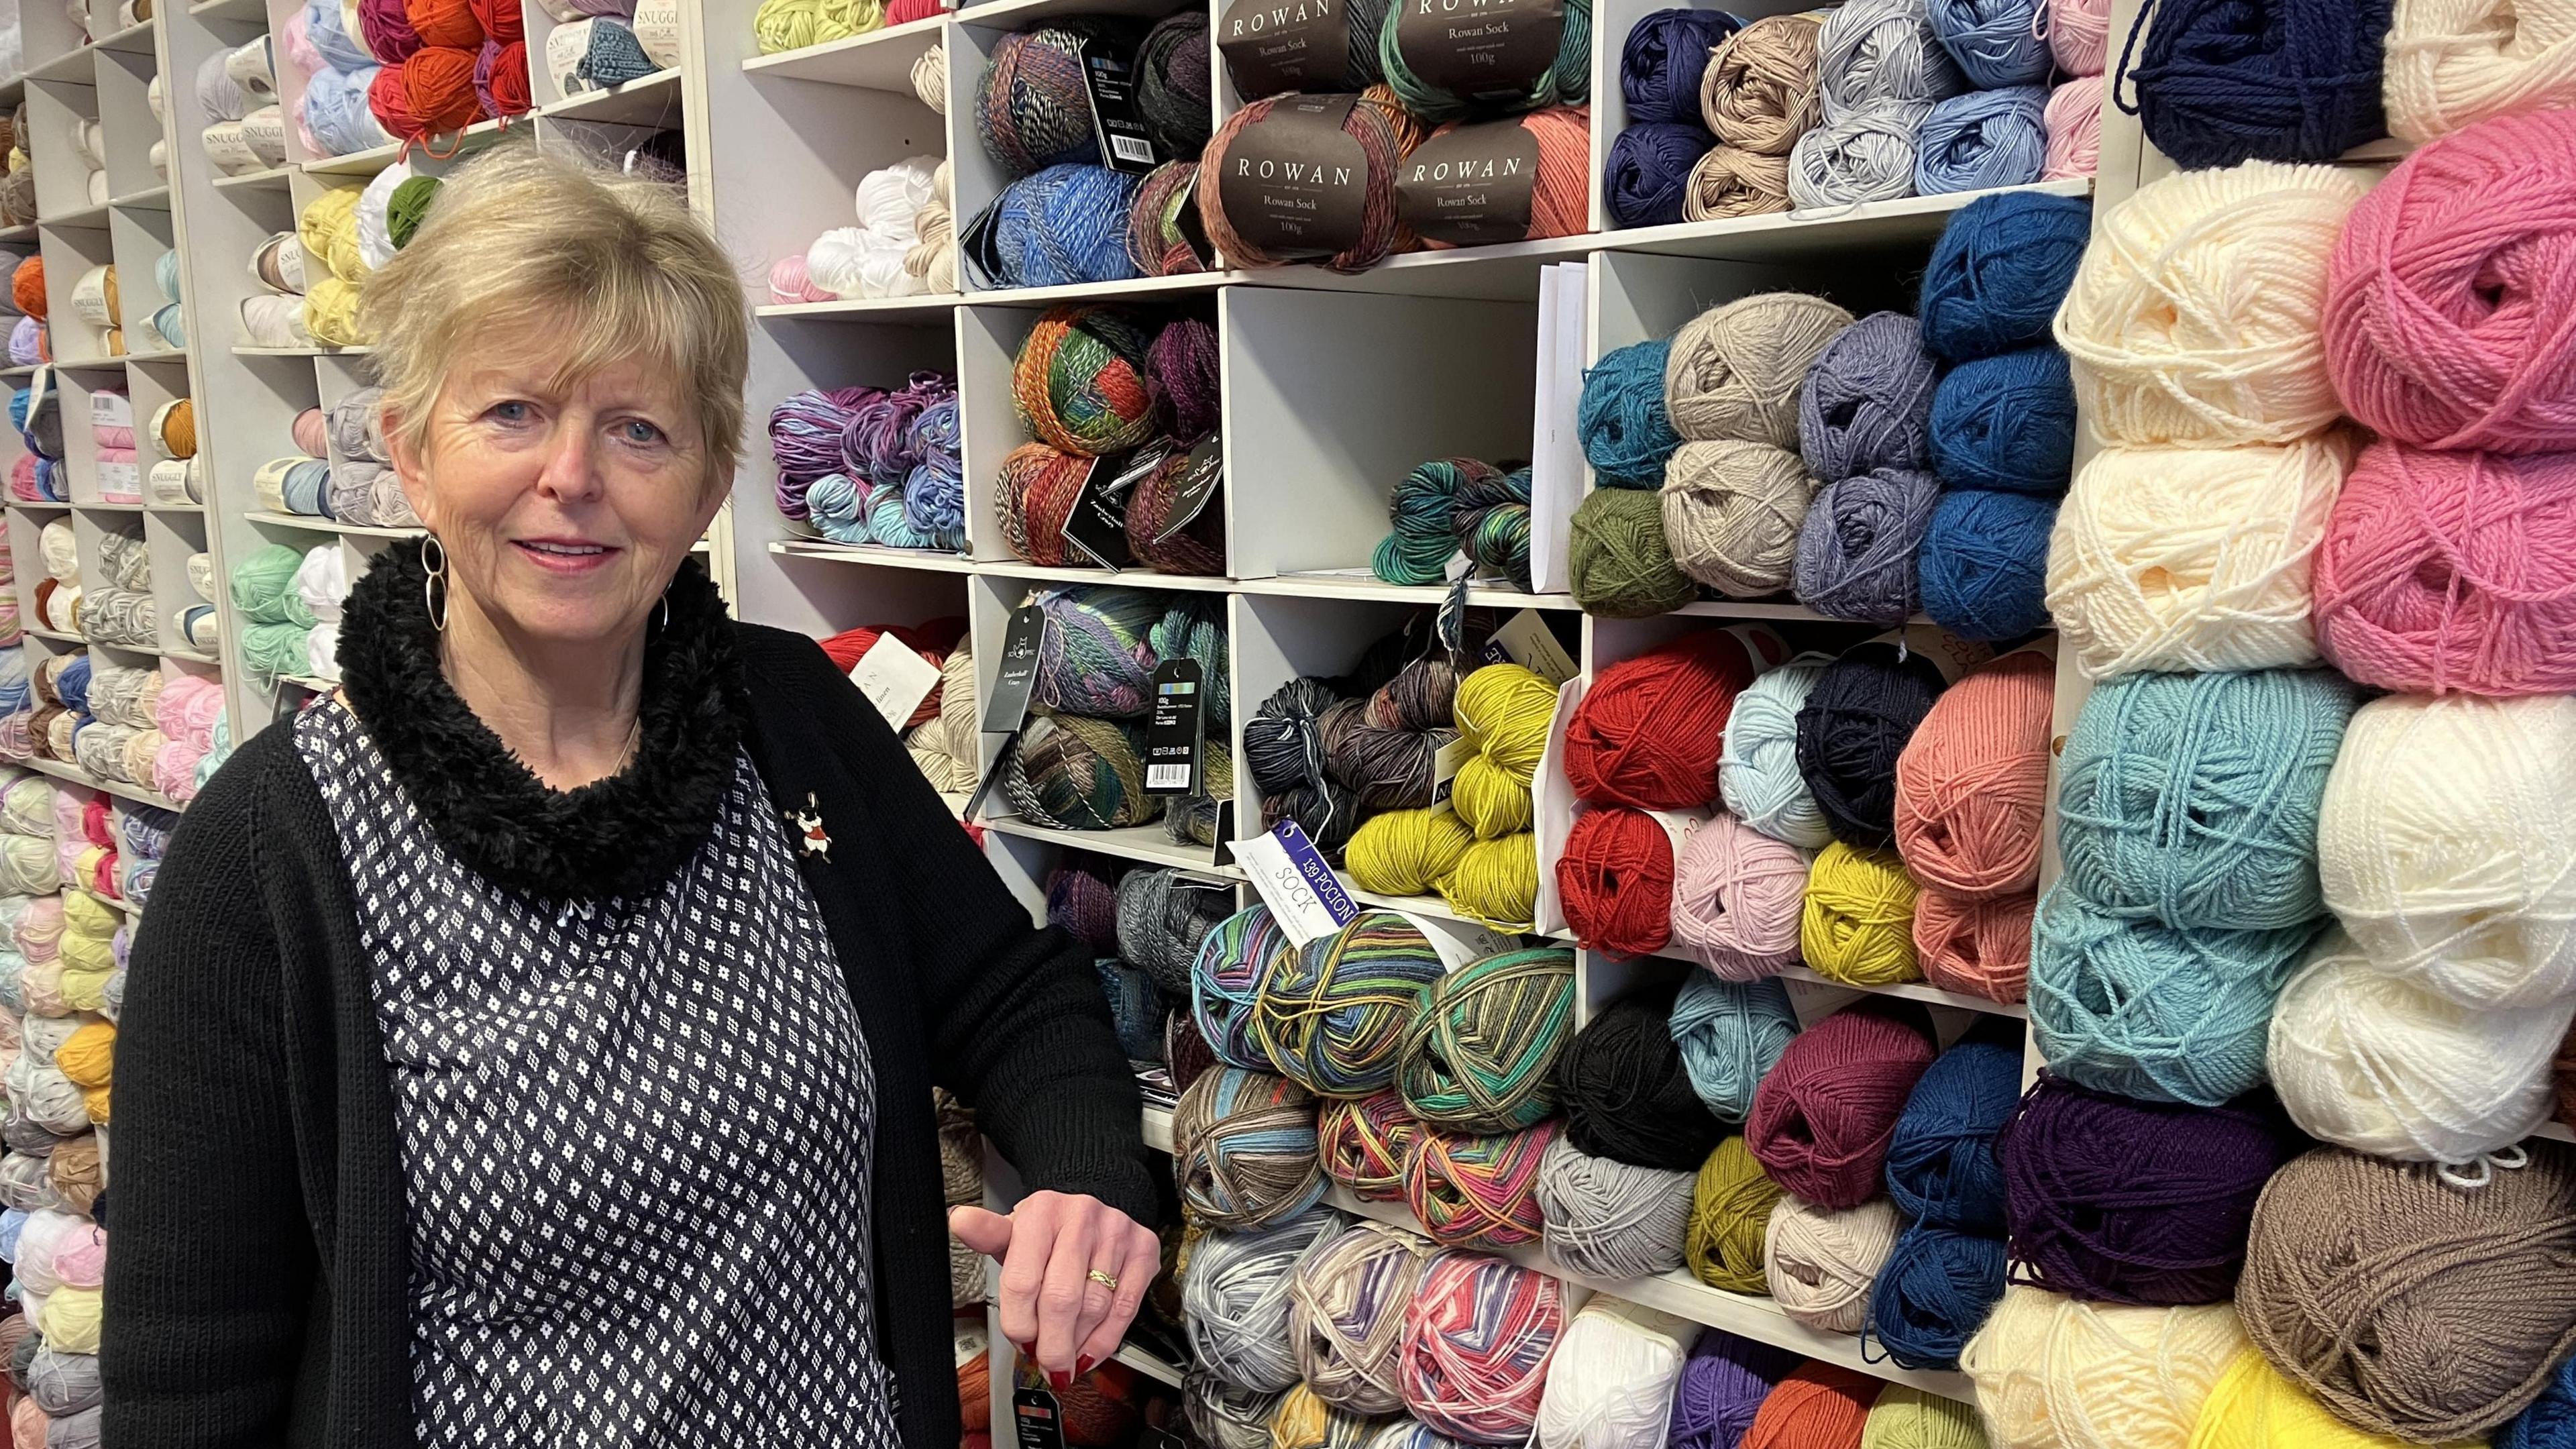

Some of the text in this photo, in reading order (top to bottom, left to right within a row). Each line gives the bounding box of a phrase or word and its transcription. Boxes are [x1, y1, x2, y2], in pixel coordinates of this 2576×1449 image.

[1232, 0, 1329, 36] ROWAN
[1448, 21, 1509, 39] Rowan Sock
[1258, 37, 1307, 57] Rowan Sock
[1470, 52, 1496, 65] 100g
[1238, 158, 1351, 186] ROWAN
[1412, 158, 1521, 182] ROWAN
[1263, 195, 1318, 210] Rowan Sock
[1437, 193, 1487, 207] Rowan Sock
[1281, 221, 1303, 235] 100g
[1158, 696, 1169, 705] 100g
[1275, 867, 1318, 914] SOCK
[1302, 857, 1355, 922] 139 POCION
